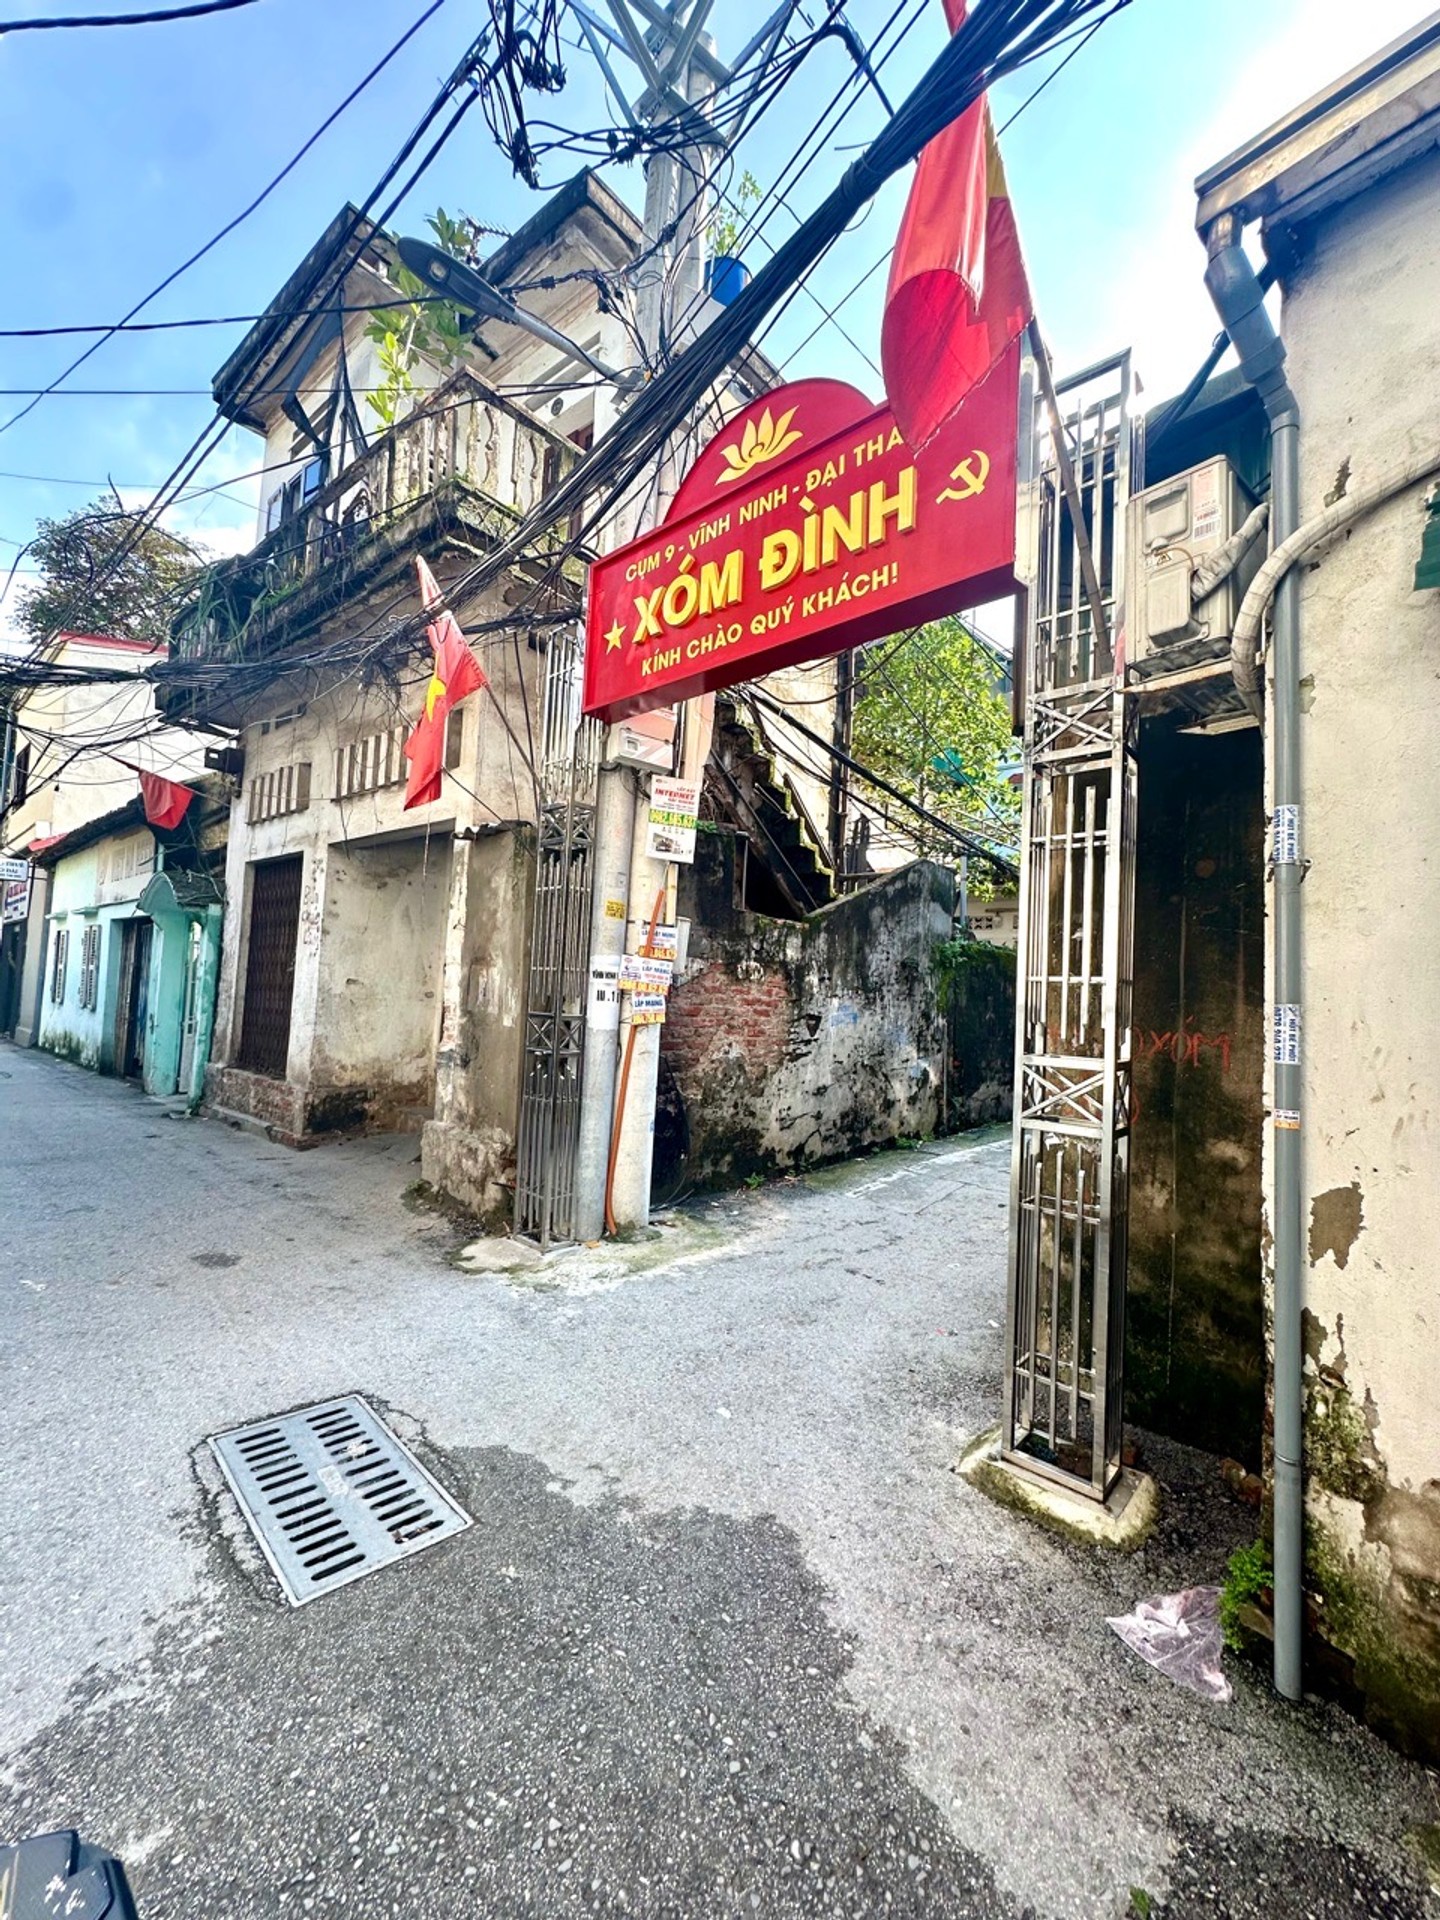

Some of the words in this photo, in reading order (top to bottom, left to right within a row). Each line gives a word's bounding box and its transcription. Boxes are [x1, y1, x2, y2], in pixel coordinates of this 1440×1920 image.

[625, 551, 661, 582] CỤM
[664, 544, 675, 563] 9
[689, 513, 731, 550] VĨNH
[739, 484, 787, 525] NINH
[805, 453, 845, 492] ĐẠI
[853, 426, 904, 467] THA
[632, 549, 744, 645] XÓM
[758, 465, 917, 592] ĐÌNH
[642, 648, 681, 677] KÍNH
[686, 622, 743, 659] CHÀO
[750, 595, 794, 635] QUÝ
[802, 562, 898, 618] KHÁCH!
[655, 788, 695, 800] INTERNET
